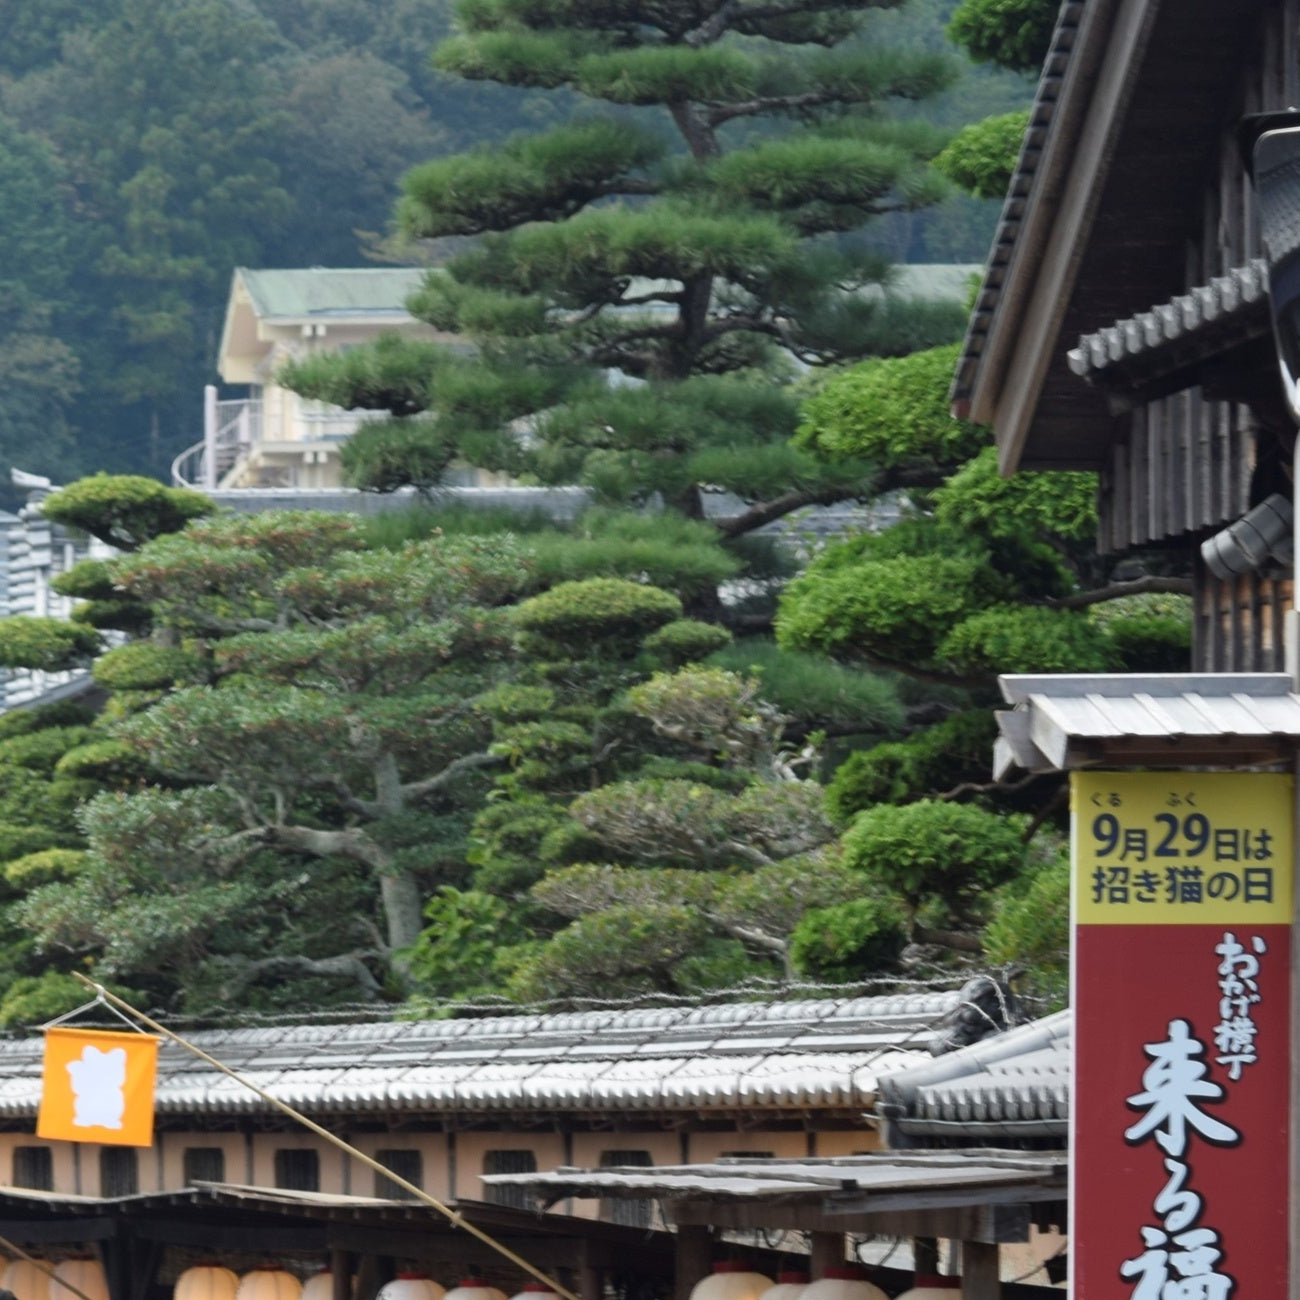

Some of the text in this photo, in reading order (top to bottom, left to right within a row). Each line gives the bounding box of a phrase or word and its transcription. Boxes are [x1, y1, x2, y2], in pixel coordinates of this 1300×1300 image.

[1090, 792, 1197, 807] くる ふく
[1092, 813, 1274, 861] 9月29日は
[1091, 866, 1274, 904] 招き猫の日
[1212, 932, 1268, 1080] おかげ横丁
